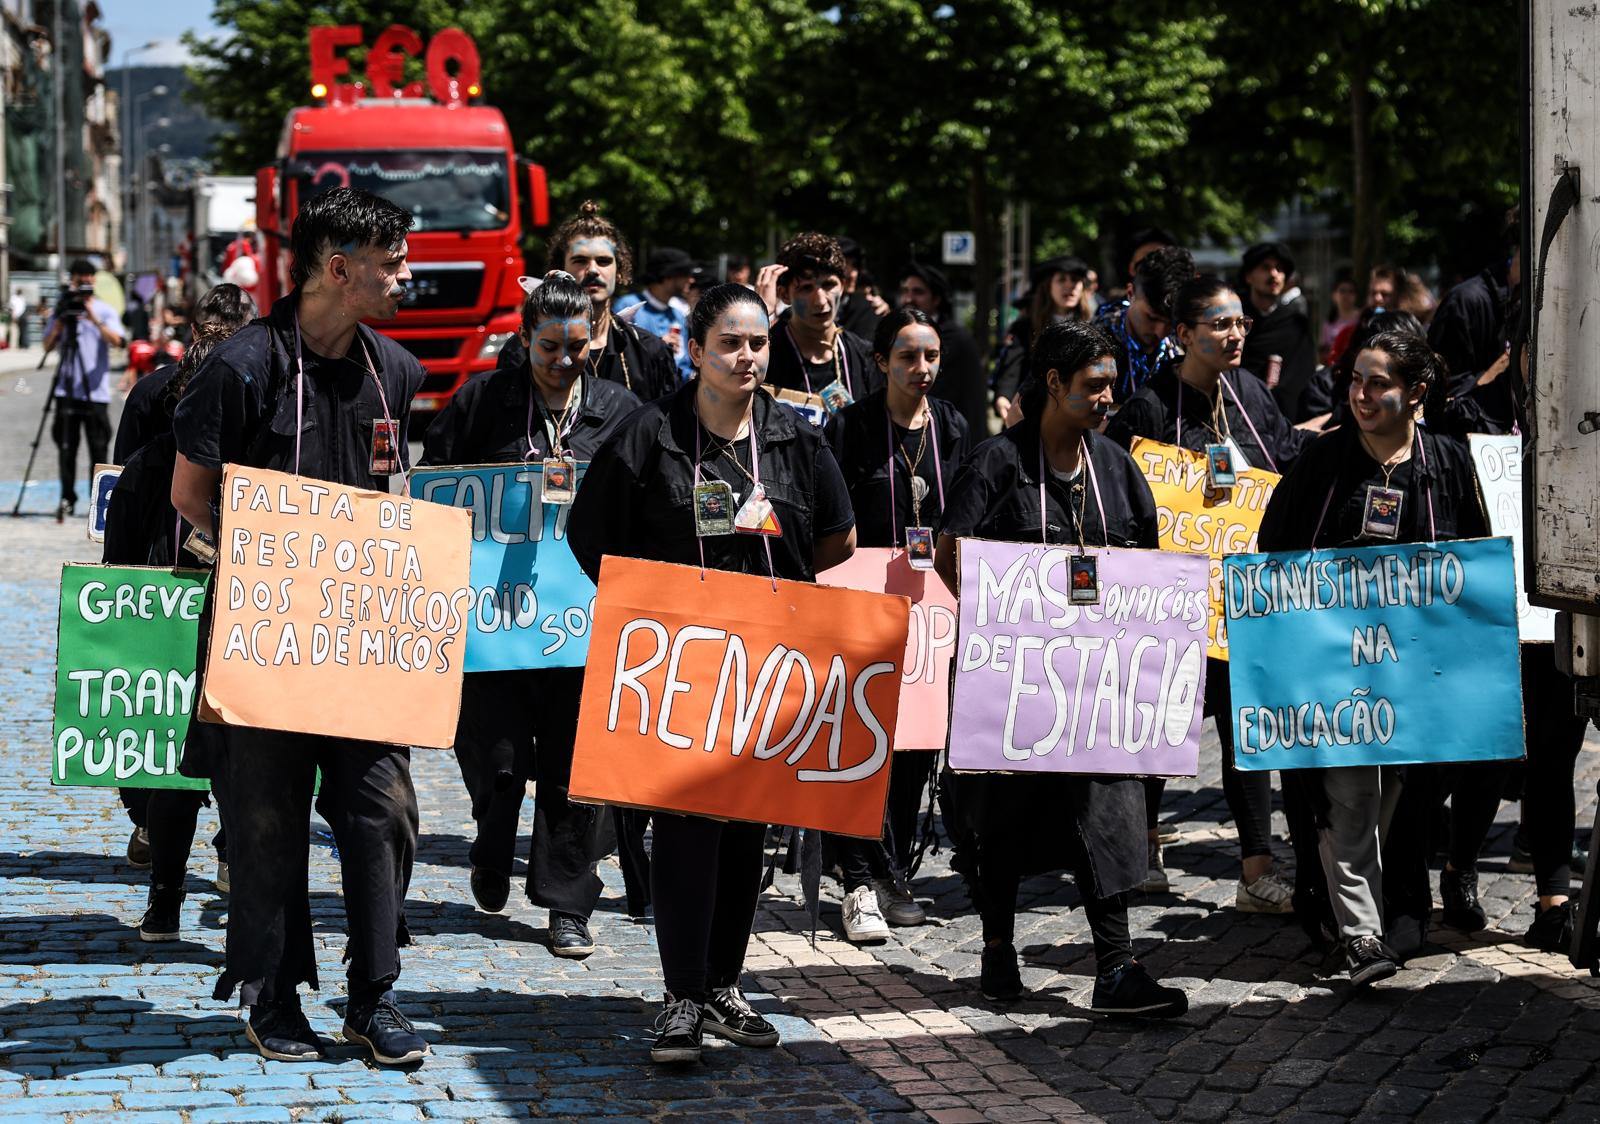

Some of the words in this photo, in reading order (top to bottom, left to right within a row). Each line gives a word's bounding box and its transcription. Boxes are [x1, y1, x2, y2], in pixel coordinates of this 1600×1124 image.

[231, 477, 354, 521] FALTA
[379, 500, 412, 530] DE
[231, 528, 422, 582] RESPOSTA
[78, 581, 205, 624] GREVE
[229, 576, 294, 614] DOS
[976, 548, 1081, 629] MÁS
[540, 596, 596, 656] SO
[1352, 623, 1399, 667] NA
[607, 618, 896, 783] RENDAS
[961, 632, 1012, 673] DE
[1002, 628, 1203, 761] ESTÁGIO
[57, 726, 186, 780] PÚBLI
